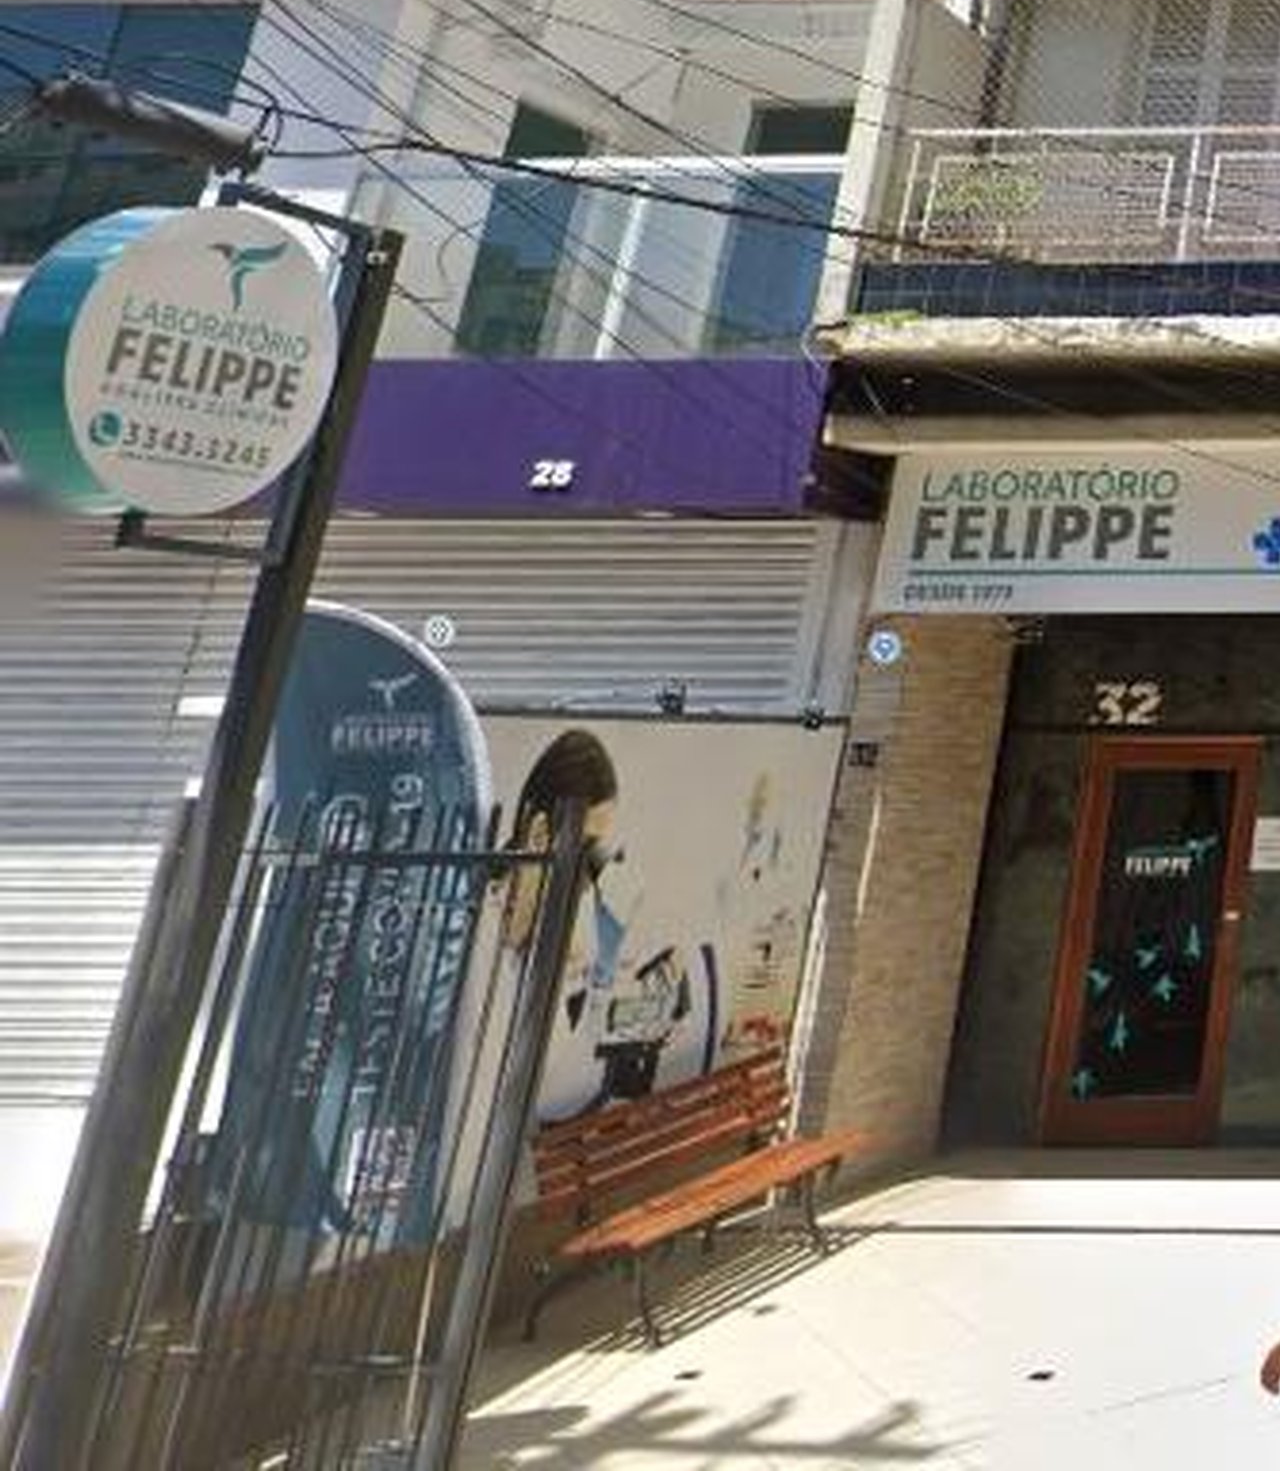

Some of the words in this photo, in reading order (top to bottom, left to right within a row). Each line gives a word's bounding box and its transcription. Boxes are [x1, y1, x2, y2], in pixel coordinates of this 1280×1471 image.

[105, 328, 302, 410] FELIPPE
[921, 463, 1181, 502] LABORATÓRIO
[910, 504, 1175, 561] FELIPPE
[1090, 681, 1163, 725] 32
